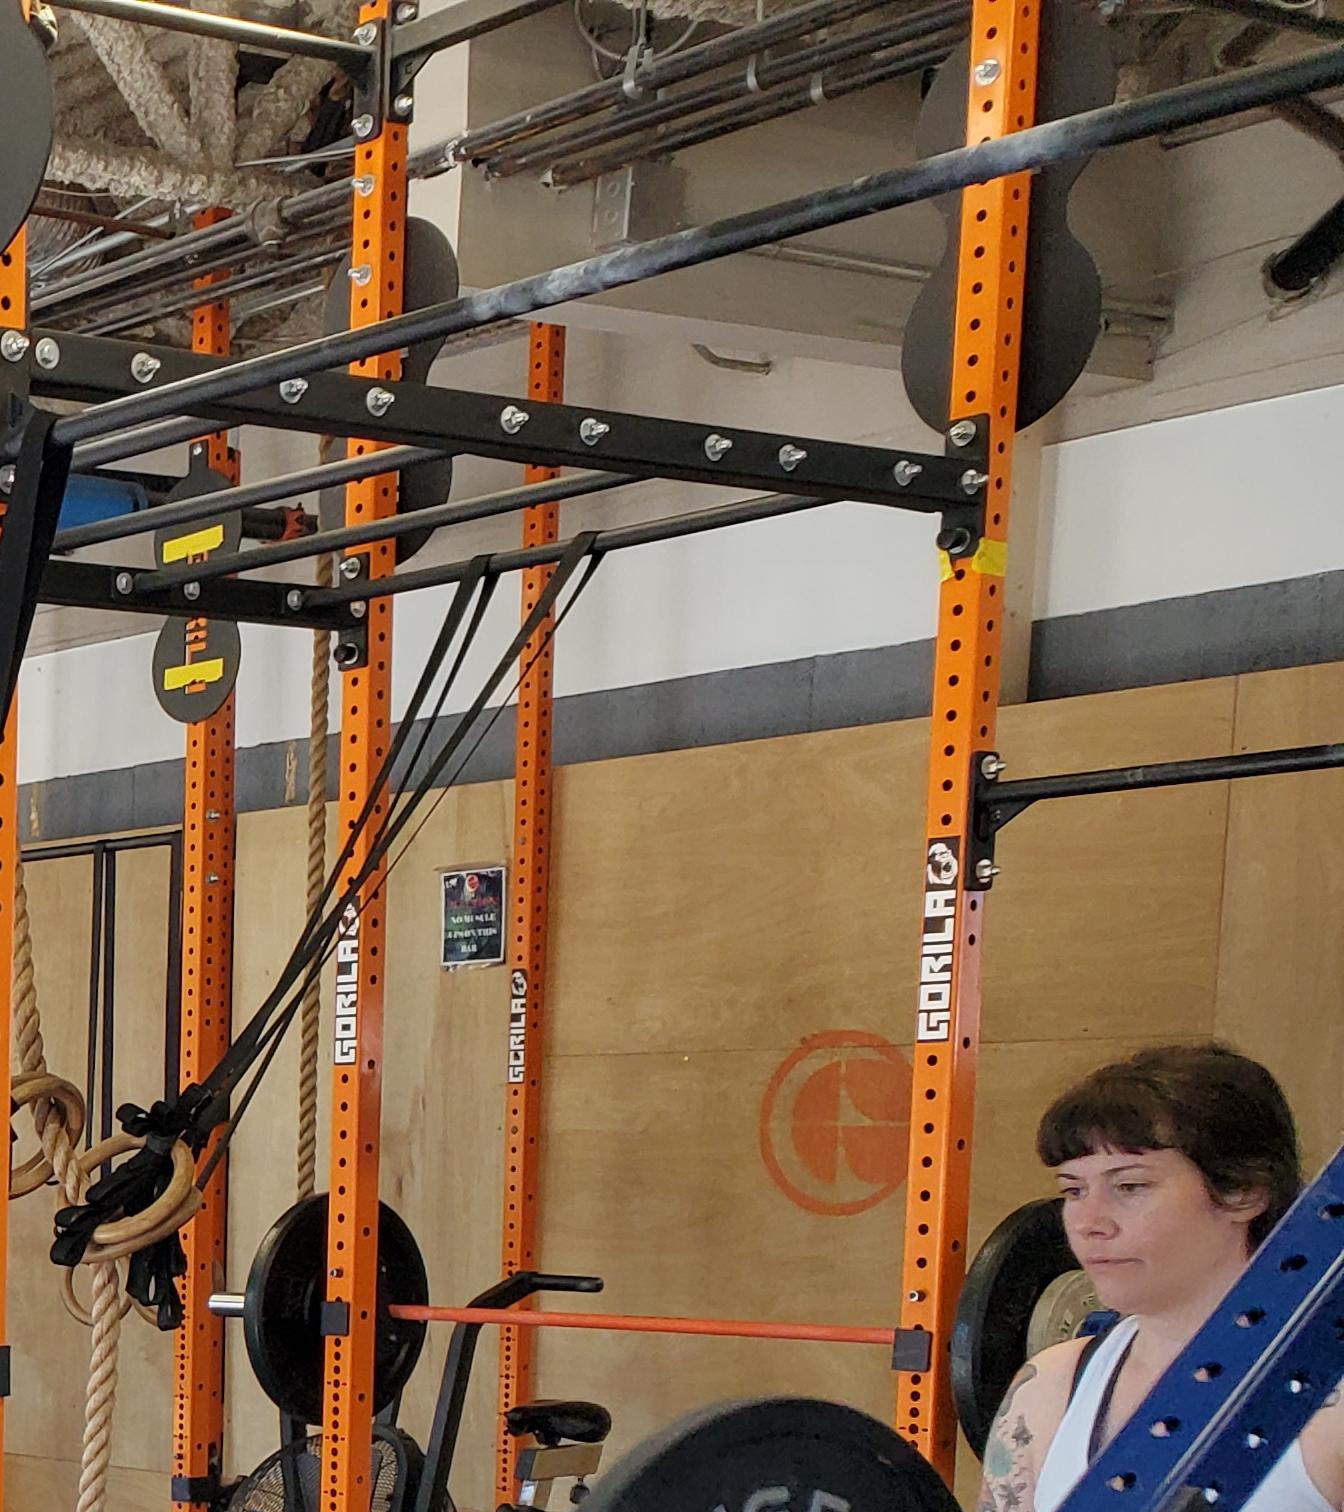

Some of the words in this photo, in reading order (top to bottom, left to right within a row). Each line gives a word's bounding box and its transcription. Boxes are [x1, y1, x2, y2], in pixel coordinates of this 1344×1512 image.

[461, 944, 477, 952] BAR
[917, 889, 957, 1041] GORILA
[334, 939, 359, 1064] GORILA
[509, 998, 526, 1083] GORILA
